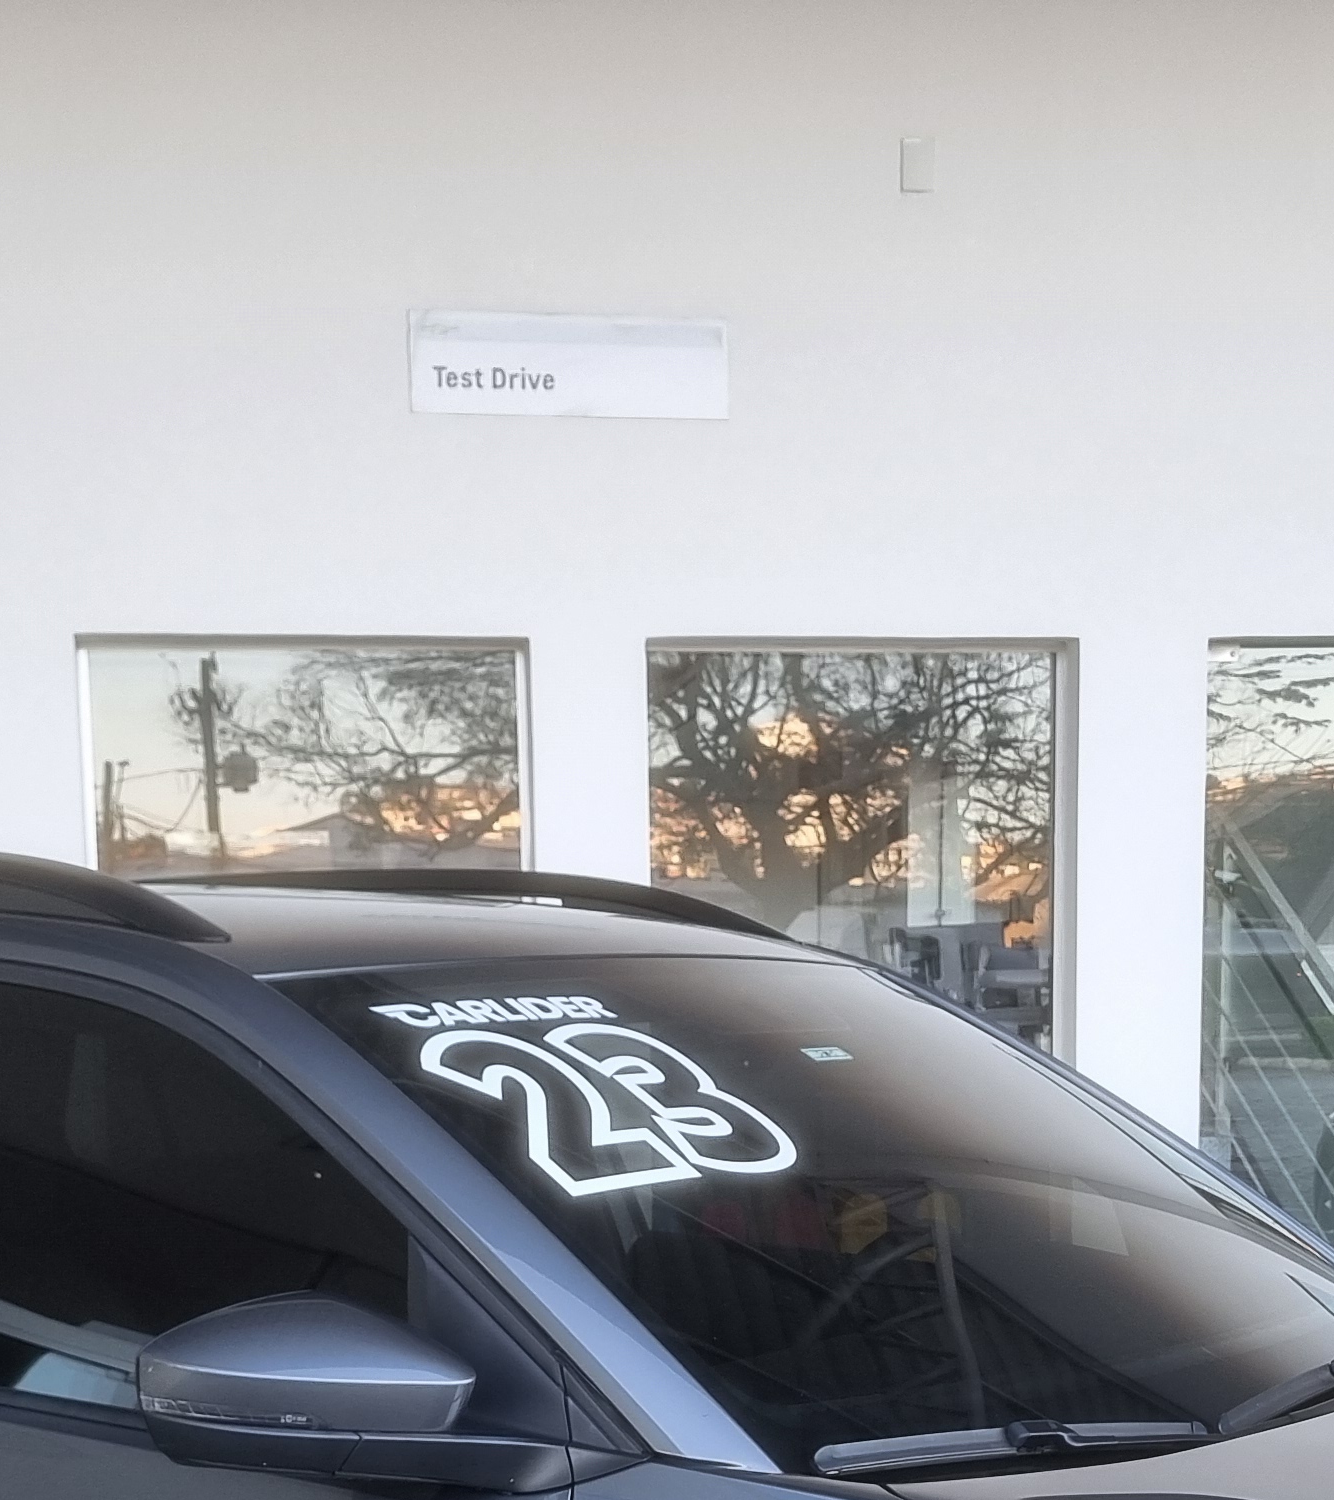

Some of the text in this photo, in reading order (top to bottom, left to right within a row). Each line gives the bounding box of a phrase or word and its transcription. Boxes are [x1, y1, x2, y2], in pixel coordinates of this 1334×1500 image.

[432, 365, 556, 391] Test Drive
[369, 995, 617, 1028] CARLIDER
[420, 1022, 798, 1197] 23
